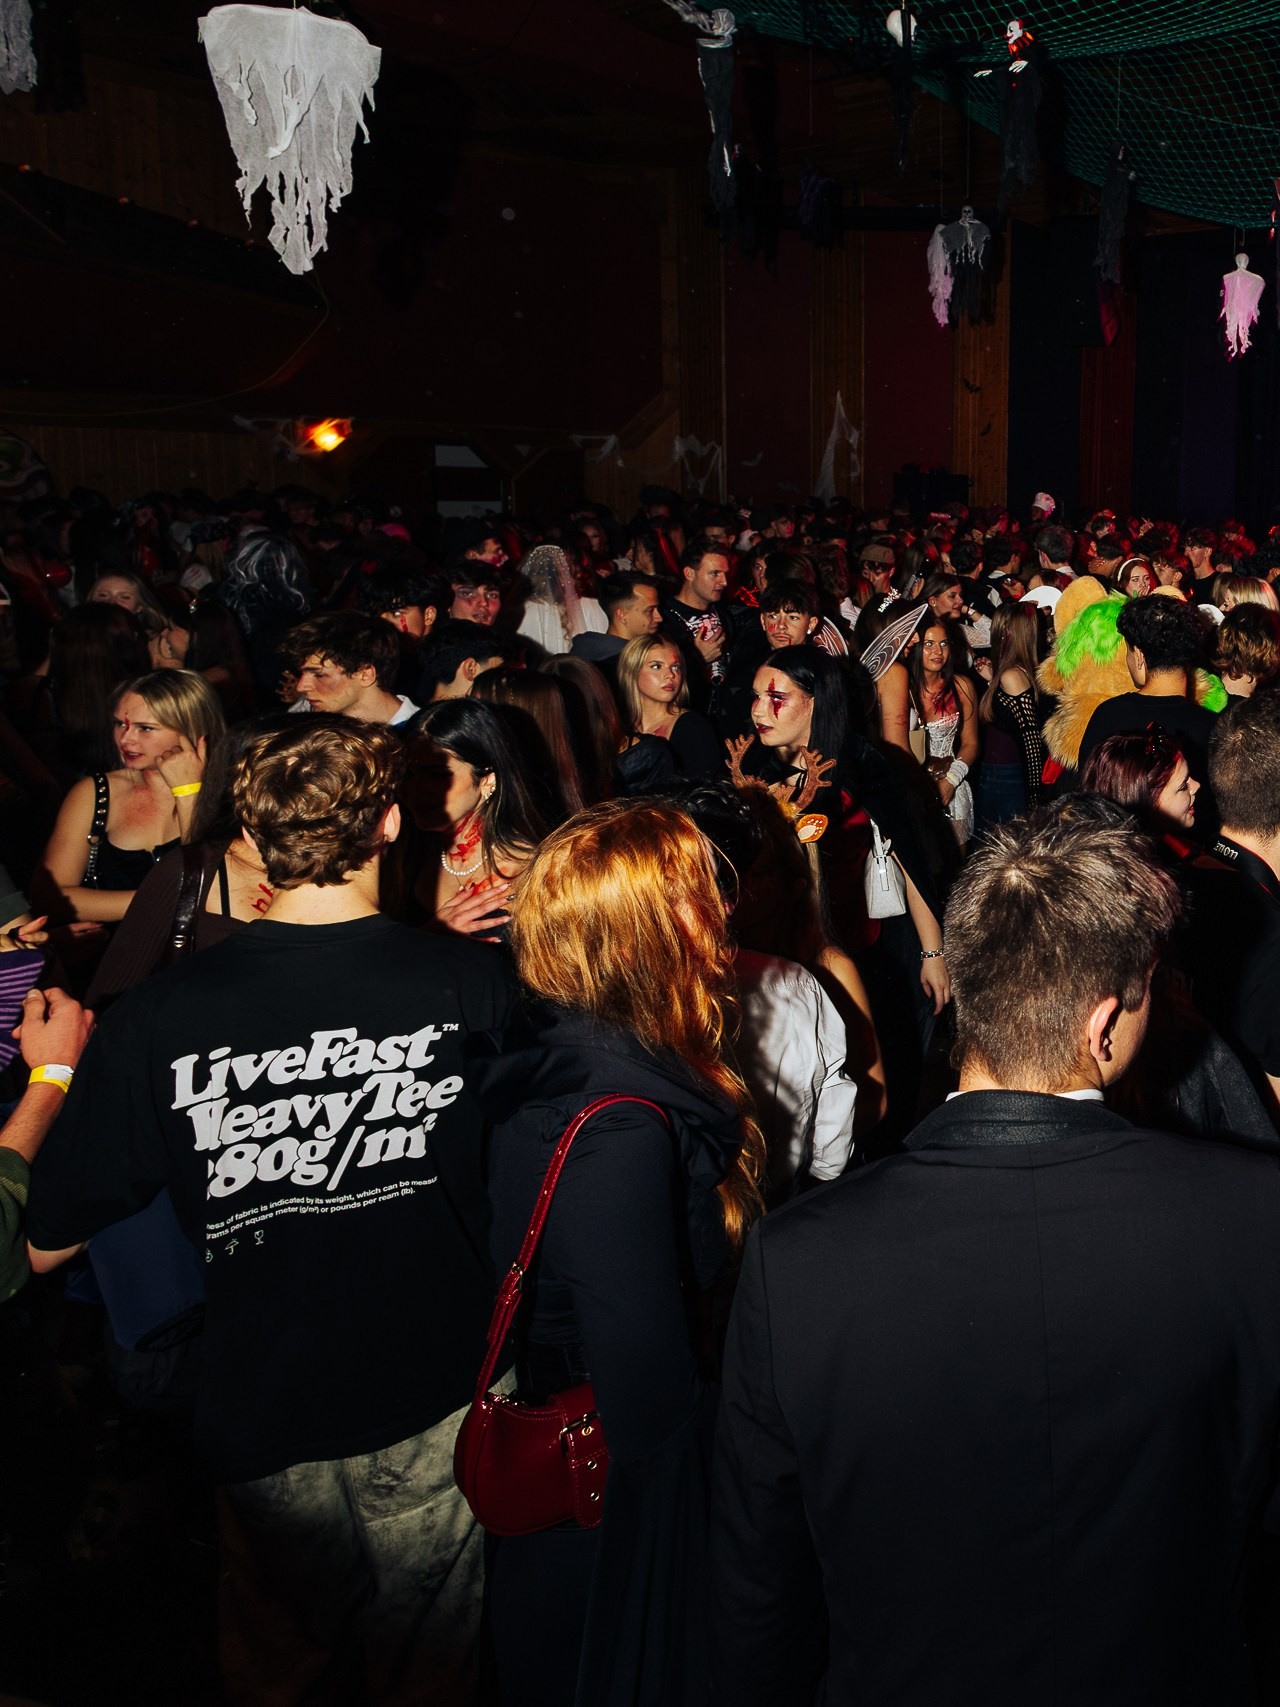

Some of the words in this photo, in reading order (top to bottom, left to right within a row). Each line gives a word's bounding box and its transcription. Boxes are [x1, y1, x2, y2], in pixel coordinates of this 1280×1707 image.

[226, 1215, 234, 1225] of
[235, 1207, 259, 1221] fabric
[260, 1204, 268, 1212] is
[269, 1196, 305, 1209] indicated
[306, 1196, 314, 1205] by
[325, 1194, 355, 1204] weight,
[356, 1187, 381, 1199] which
[382, 1183, 398, 1192] can
[399, 1180, 410, 1188] be
[230, 1221, 244, 1233] per
[245, 1212, 274, 1226] square
[275, 1206, 298, 1216] meter
[330, 1201, 362, 1213] pounds
[363, 1197, 377, 1207] per
[378, 1191, 399, 1202] ream
